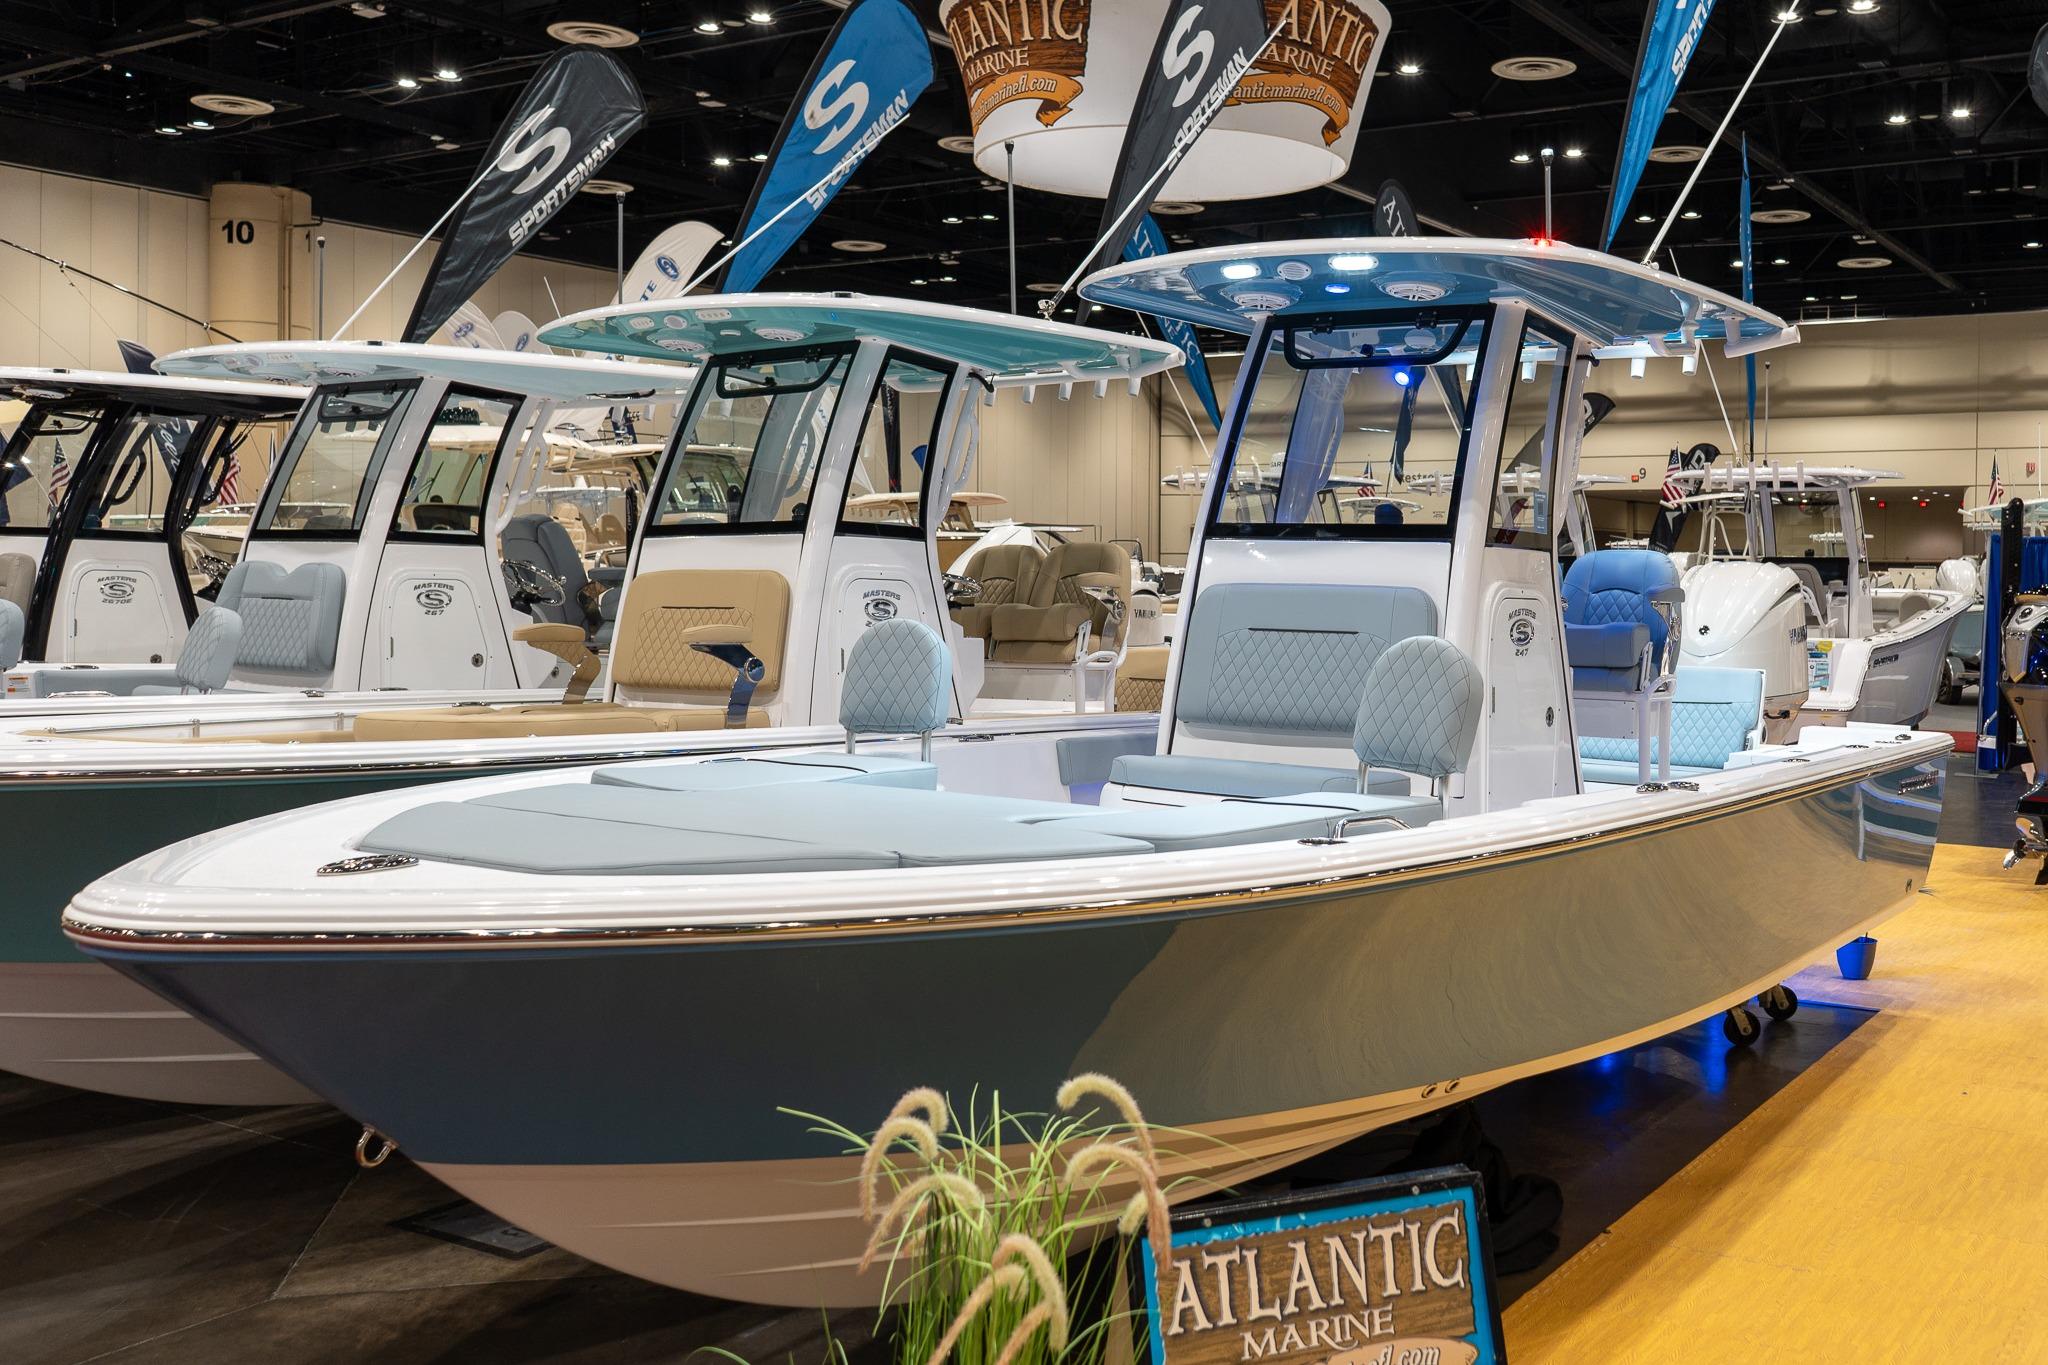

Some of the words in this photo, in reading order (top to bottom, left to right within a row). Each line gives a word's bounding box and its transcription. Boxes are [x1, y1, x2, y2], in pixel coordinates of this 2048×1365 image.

[951, 0, 1083, 71] TLANTIC
[1267, 0, 1376, 80] ANTIC
[965, 45, 1030, 86] MARINE
[1256, 43, 1336, 80] ARINE
[1232, 80, 1342, 115] anticmarinefl.com
[806, 88, 910, 211] SPORTSMAN
[508, 133, 616, 247] SPORTSMAN
[221, 219, 255, 245] 10
[1382, 195, 1407, 237] AT
[1639, 467, 1647, 480] 9
[97, 576, 137, 584] MASTERS
[413, 582, 454, 591] MASTERS
[862, 589, 901, 600] MASTERS
[1508, 608, 1537, 621] MASTERS
[1167, 1206, 1465, 1336] ATLANTIC
[1239, 1302, 1396, 1361] MARINE
